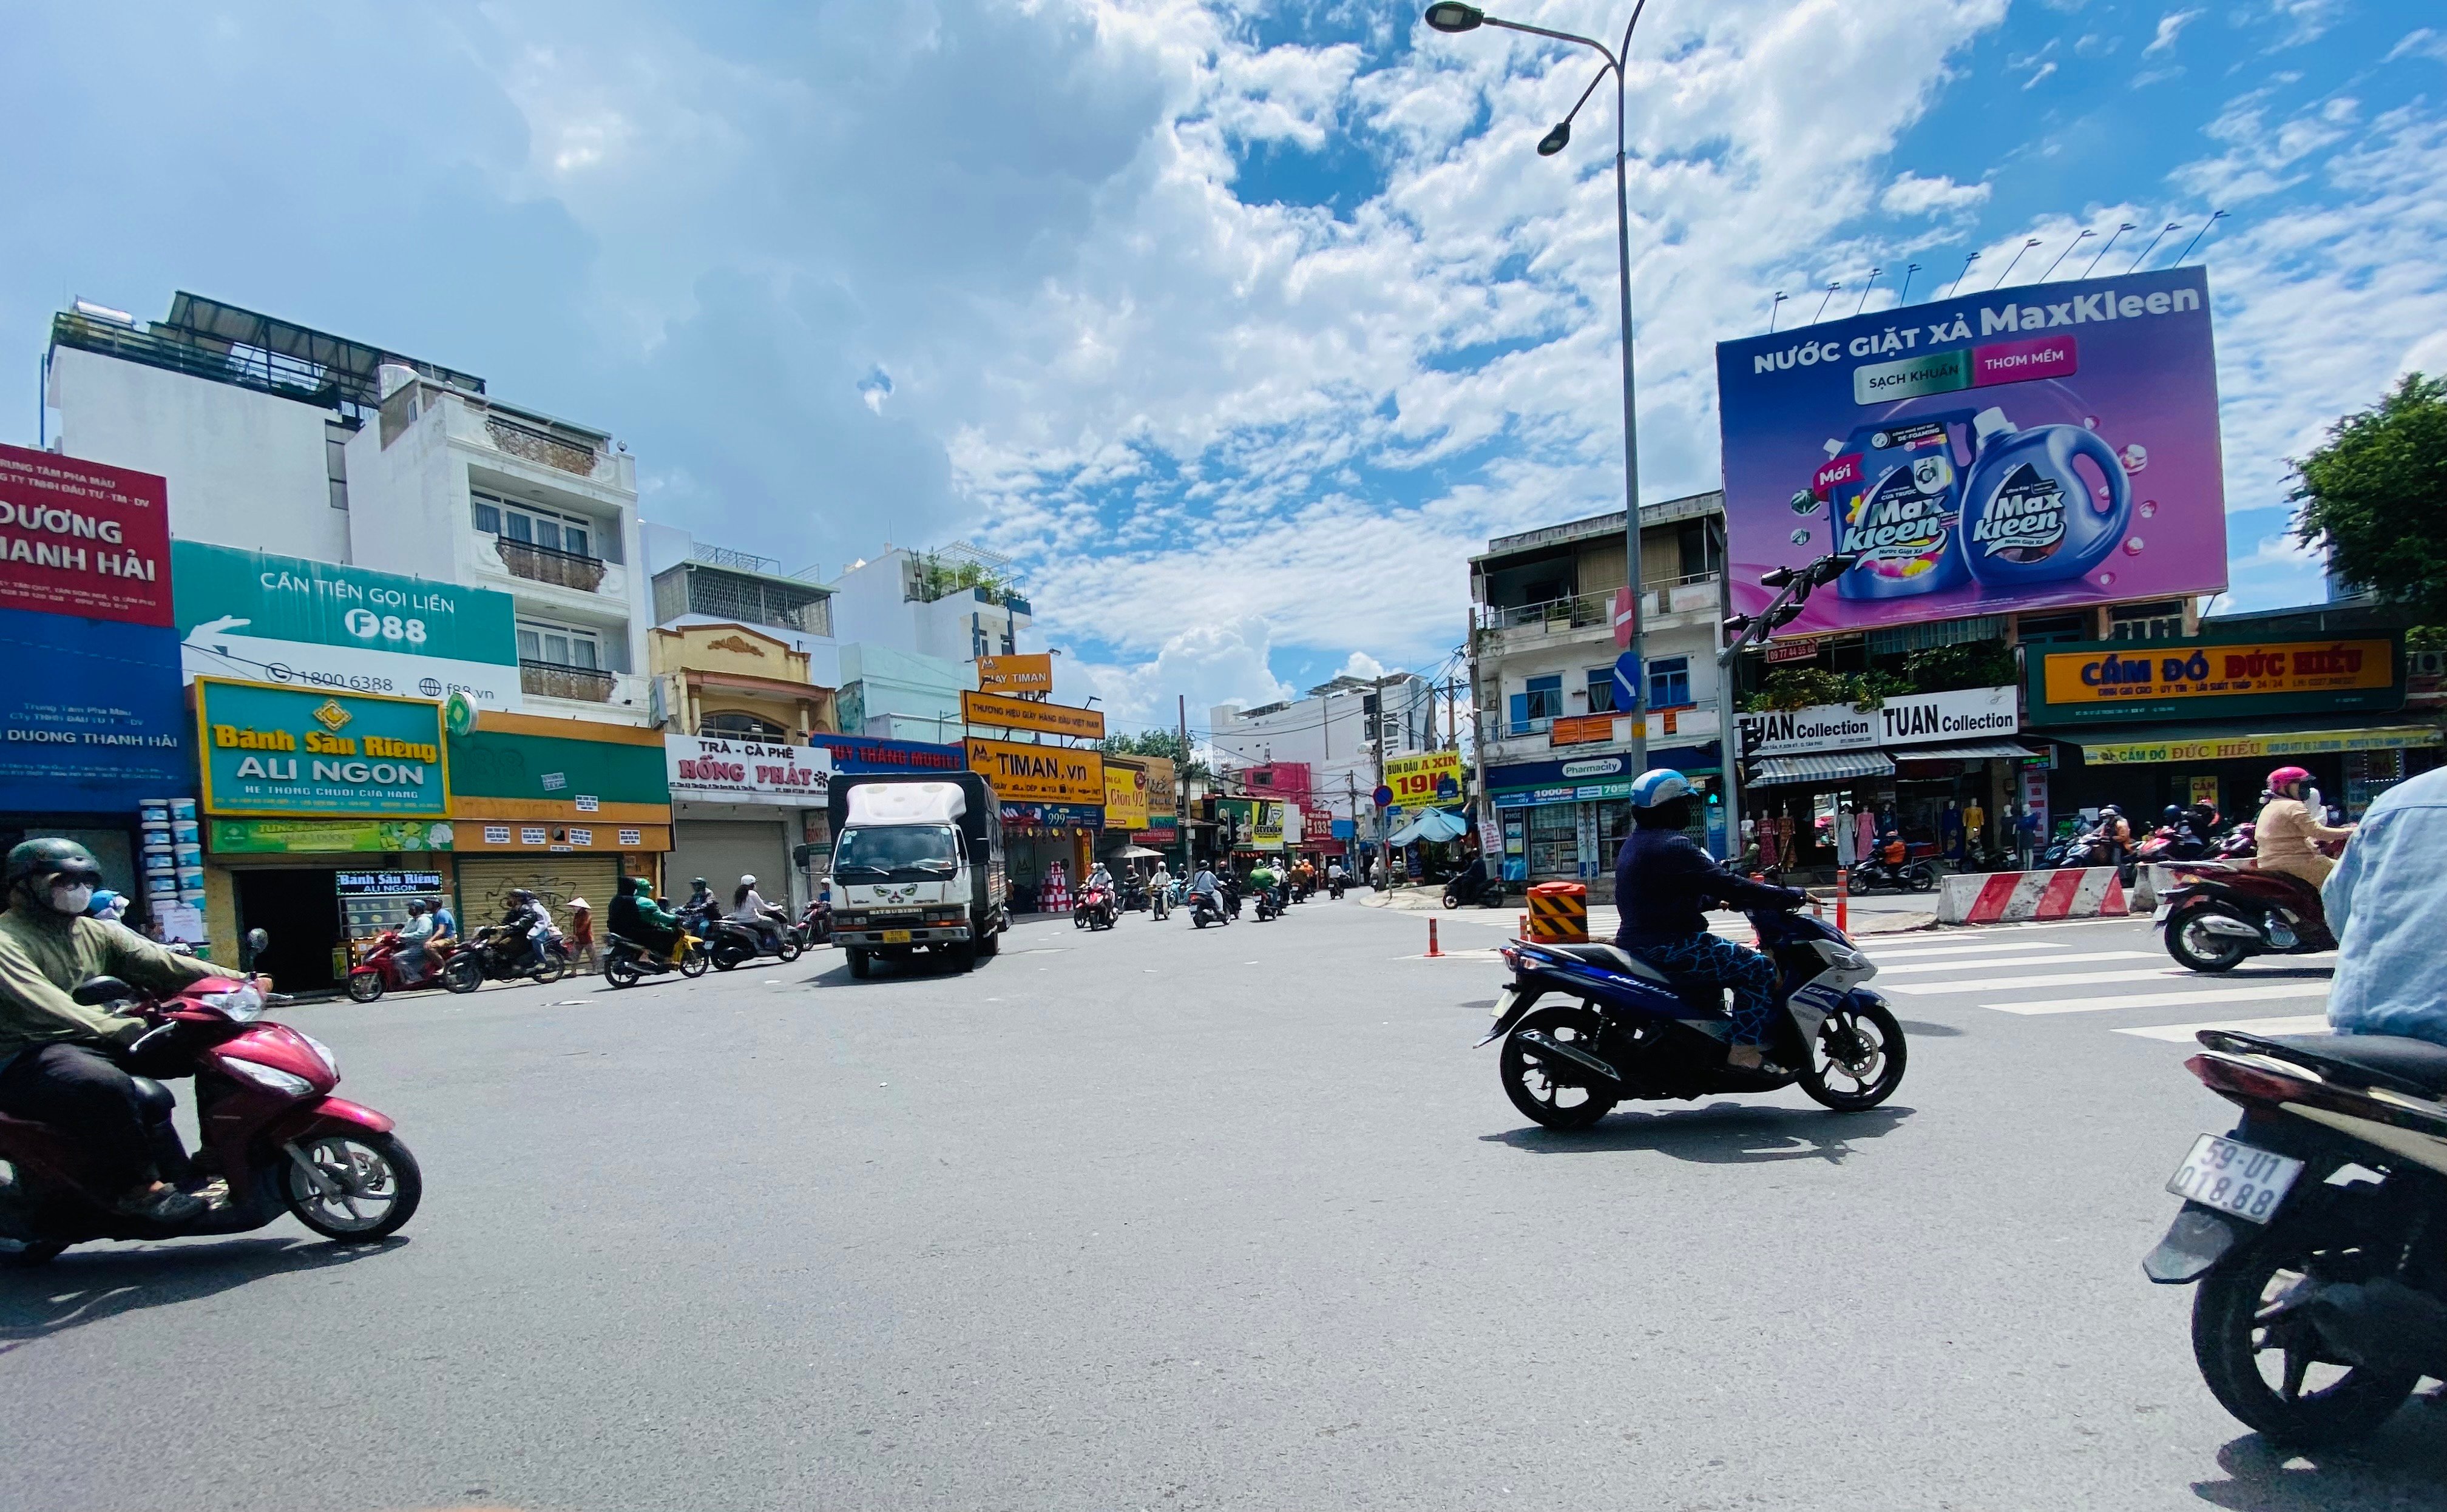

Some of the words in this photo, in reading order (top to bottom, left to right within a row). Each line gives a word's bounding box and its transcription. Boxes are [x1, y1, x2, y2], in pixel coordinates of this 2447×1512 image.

[1754, 339, 1841, 374] NƯỚC
[1849, 328, 1920, 361] GIẶT
[1928, 313, 1972, 346] XẢ
[1981, 288, 2200, 337] MaxKleen
[1985, 353, 2028, 370] THƠM
[2031, 348, 2065, 365] MỀM
[1869, 371, 1907, 390] SẠCH
[1898, 427, 1940, 442] DE-FOAMING
[1819, 463, 1852, 485] Mới
[1868, 496, 1948, 530] Max
[1996, 491, 2065, 519] Max
[0, 536, 87, 571] ANH
[96, 548, 156, 581] HẢI
[260, 571, 310, 593] CẦN
[314, 579, 363, 600] TIỀN
[369, 587, 407, 608] GỌI
[413, 593, 455, 613] LIỀN
[345, 609, 427, 643] F88
[1779, 649, 1787, 658] 77
[2225, 650, 2286, 678] ĐỨC
[300, 670, 344, 688] 1800
[350, 675, 393, 692] 6388
[1012, 672, 1046, 683] TIMAN
[1796, 719, 1869, 739] Collection
[1883, 704, 1938, 737] TUAN
[1942, 712, 2013, 732] Collection
[83, 733, 143, 746] THANH
[148, 734, 178, 748] HẢI
[214, 726, 296, 751] Bánh
[362, 735, 437, 764] Riêng
[699, 740, 731, 754] TRÀ
[745, 744, 765, 757] CÀ
[768, 747, 794, 759] PHÊ
[2171, 744, 2210, 759] ĐỨC
[2216, 740, 2261, 757] HIẾU
[237, 756, 297, 780] ALI
[312, 760, 424, 785] NGON
[679, 755, 746, 782] HỒNG
[756, 761, 813, 786] PHÁT
[911, 752, 961, 769] MOBILE
[995, 752, 1088, 781] TIMAN.vn
[1387, 762, 1402, 775] BÚN
[1421, 760, 1429, 770] A
[1565, 760, 1618, 775] Pharmacity
[1132, 791, 1144, 807] 92
[1604, 785, 1617, 794] 70
[1048, 812, 1066, 825] 999
[1313, 821, 1327, 834] 133
[340, 874, 375, 885] Bánh
[404, 874, 440, 885] Riêng
[1608, 975, 1679, 999] NOUVO
[1804, 987, 1833, 996] GP
[2201, 1139, 2281, 1184] 59-U1
[2178, 1166, 2275, 1215] 018.88
